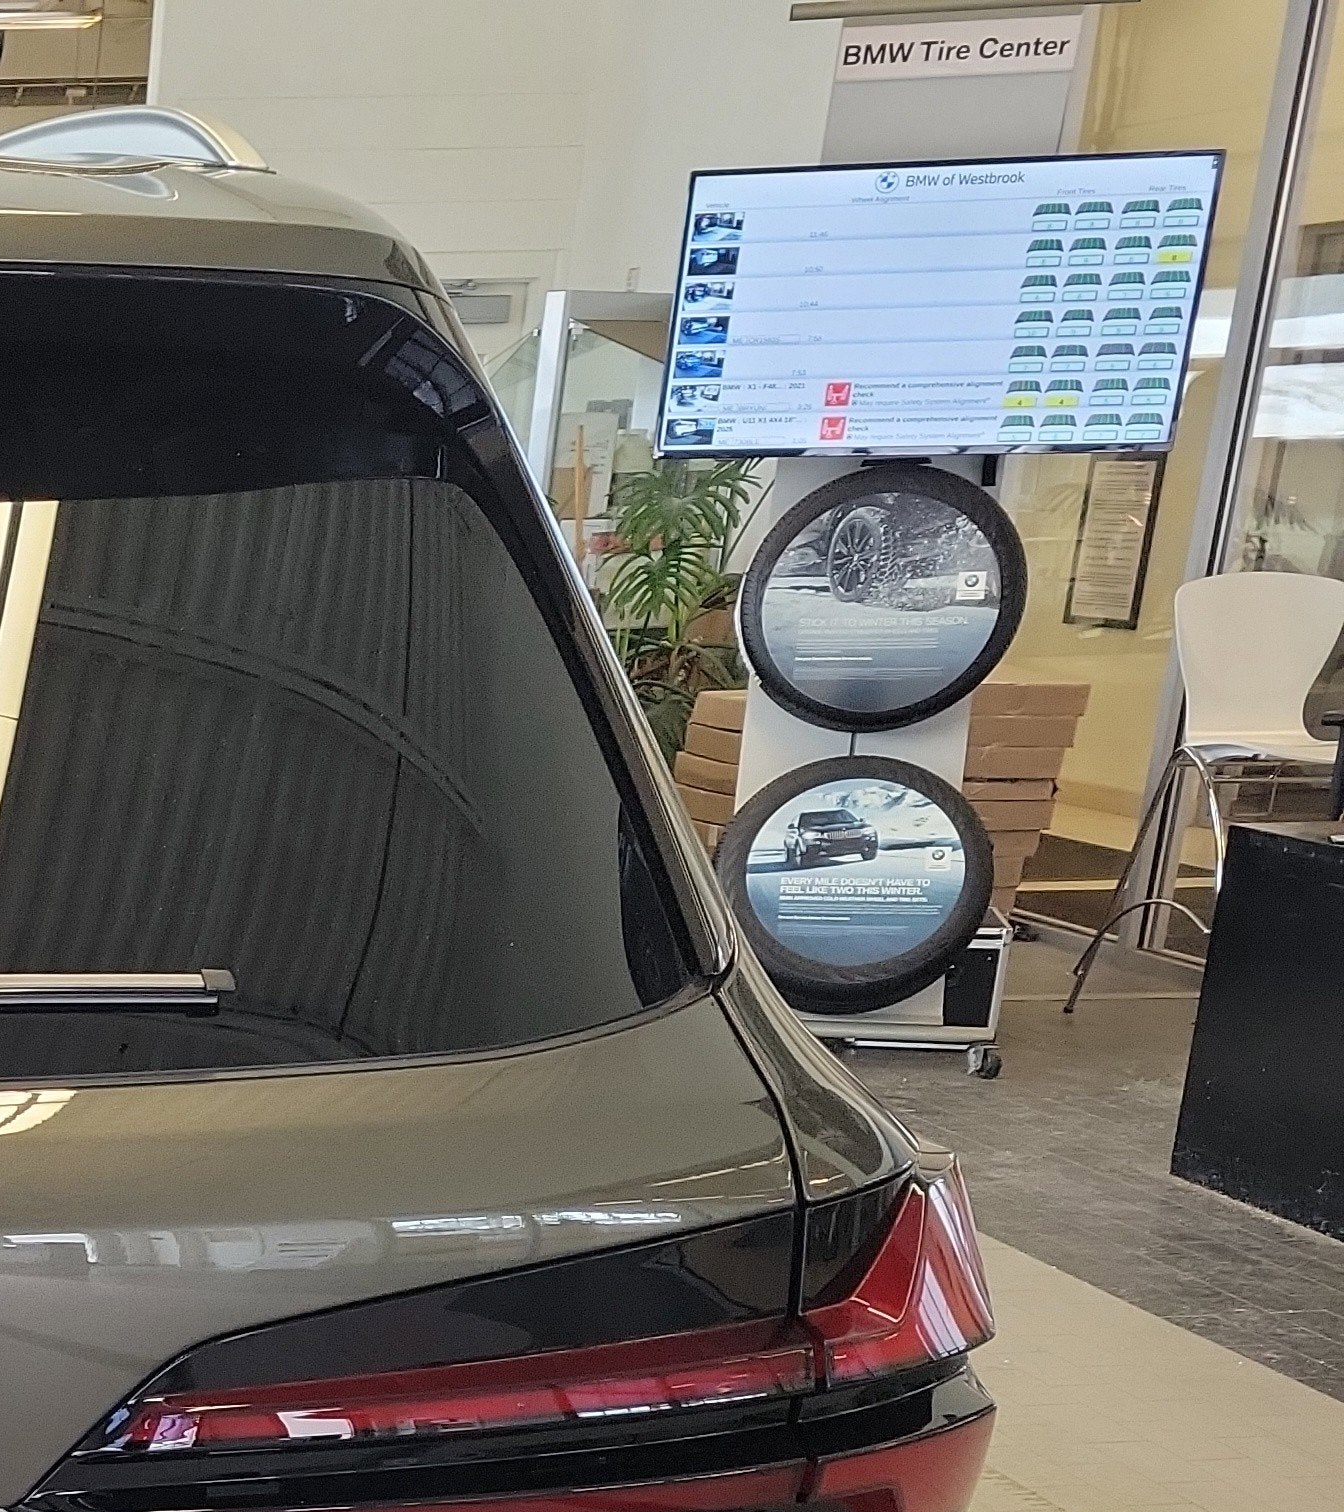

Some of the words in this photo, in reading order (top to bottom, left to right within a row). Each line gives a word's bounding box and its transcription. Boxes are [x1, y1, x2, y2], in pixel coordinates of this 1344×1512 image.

[842, 42, 915, 66] BMW
[920, 40, 971, 61] Tire
[979, 37, 1071, 59] Center
[906, 175, 940, 187] BMW
[942, 173, 955, 186] of
[958, 171, 1025, 185] Westbrook
[780, 877, 814, 885] EVERY
[815, 877, 838, 886] MILE
[840, 878, 883, 886] DOESN'T
[916, 879, 930, 887] TO
[780, 886, 805, 894] FEEL
[806, 886, 829, 894] LIKE
[831, 886, 854, 894] TWO
[857, 887, 879, 895] THIS
[881, 887, 923, 895] WINTER.
